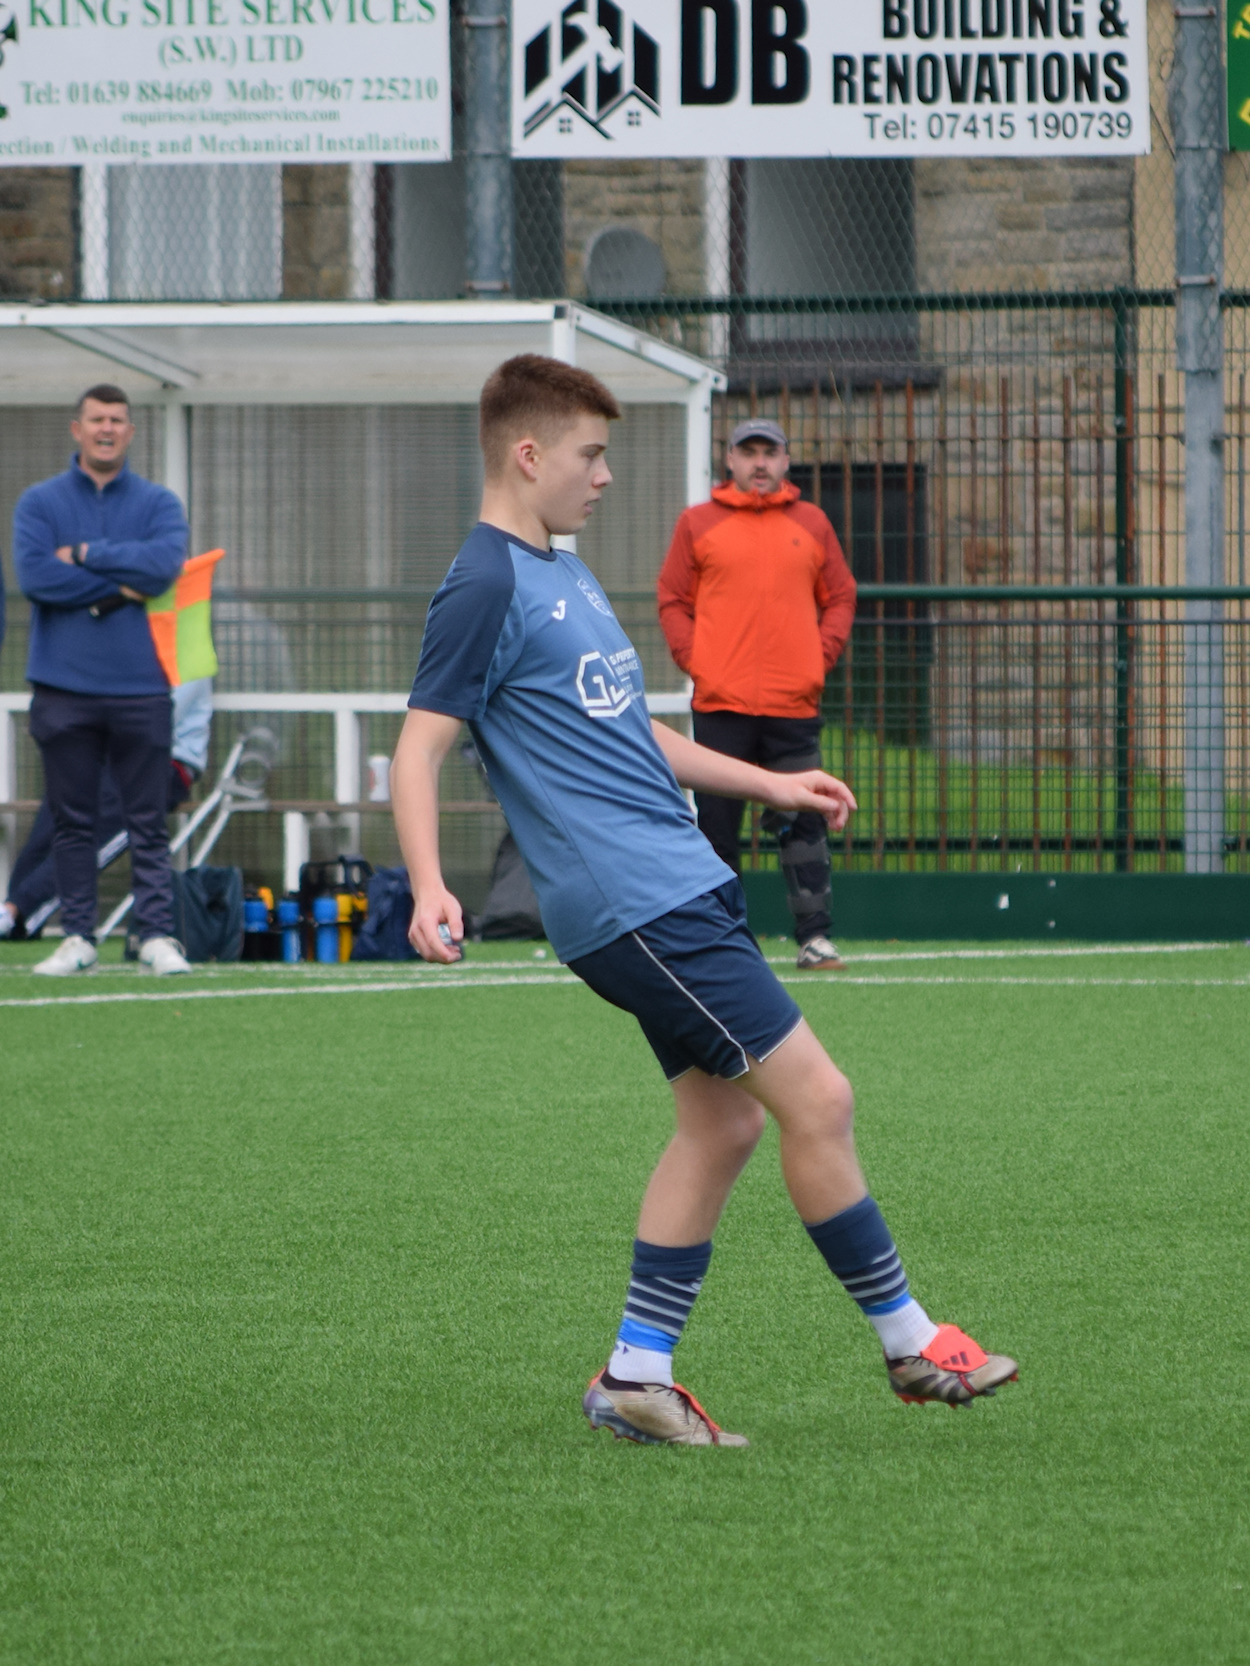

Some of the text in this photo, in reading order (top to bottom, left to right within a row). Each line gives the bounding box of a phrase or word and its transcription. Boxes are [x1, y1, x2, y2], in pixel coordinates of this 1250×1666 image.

[29, 0, 437, 27] KING SITE SERVICES
[882, 0, 1128, 40] BUILDING &
[158, 34, 304, 69] (S.W.) LTD
[680, 0, 810, 106] DB
[20, 76, 439, 105] Tel: 01639 884669 Mob: 07967 225210
[832, 51, 1130, 106] RENOVATIONS
[863, 110, 1133, 140] Tel: 07415 190739
[72, 135, 152, 158] Welding
[157, 136, 192, 154] and
[199, 133, 310, 154] Mechanical
[317, 131, 440, 152] Installations
